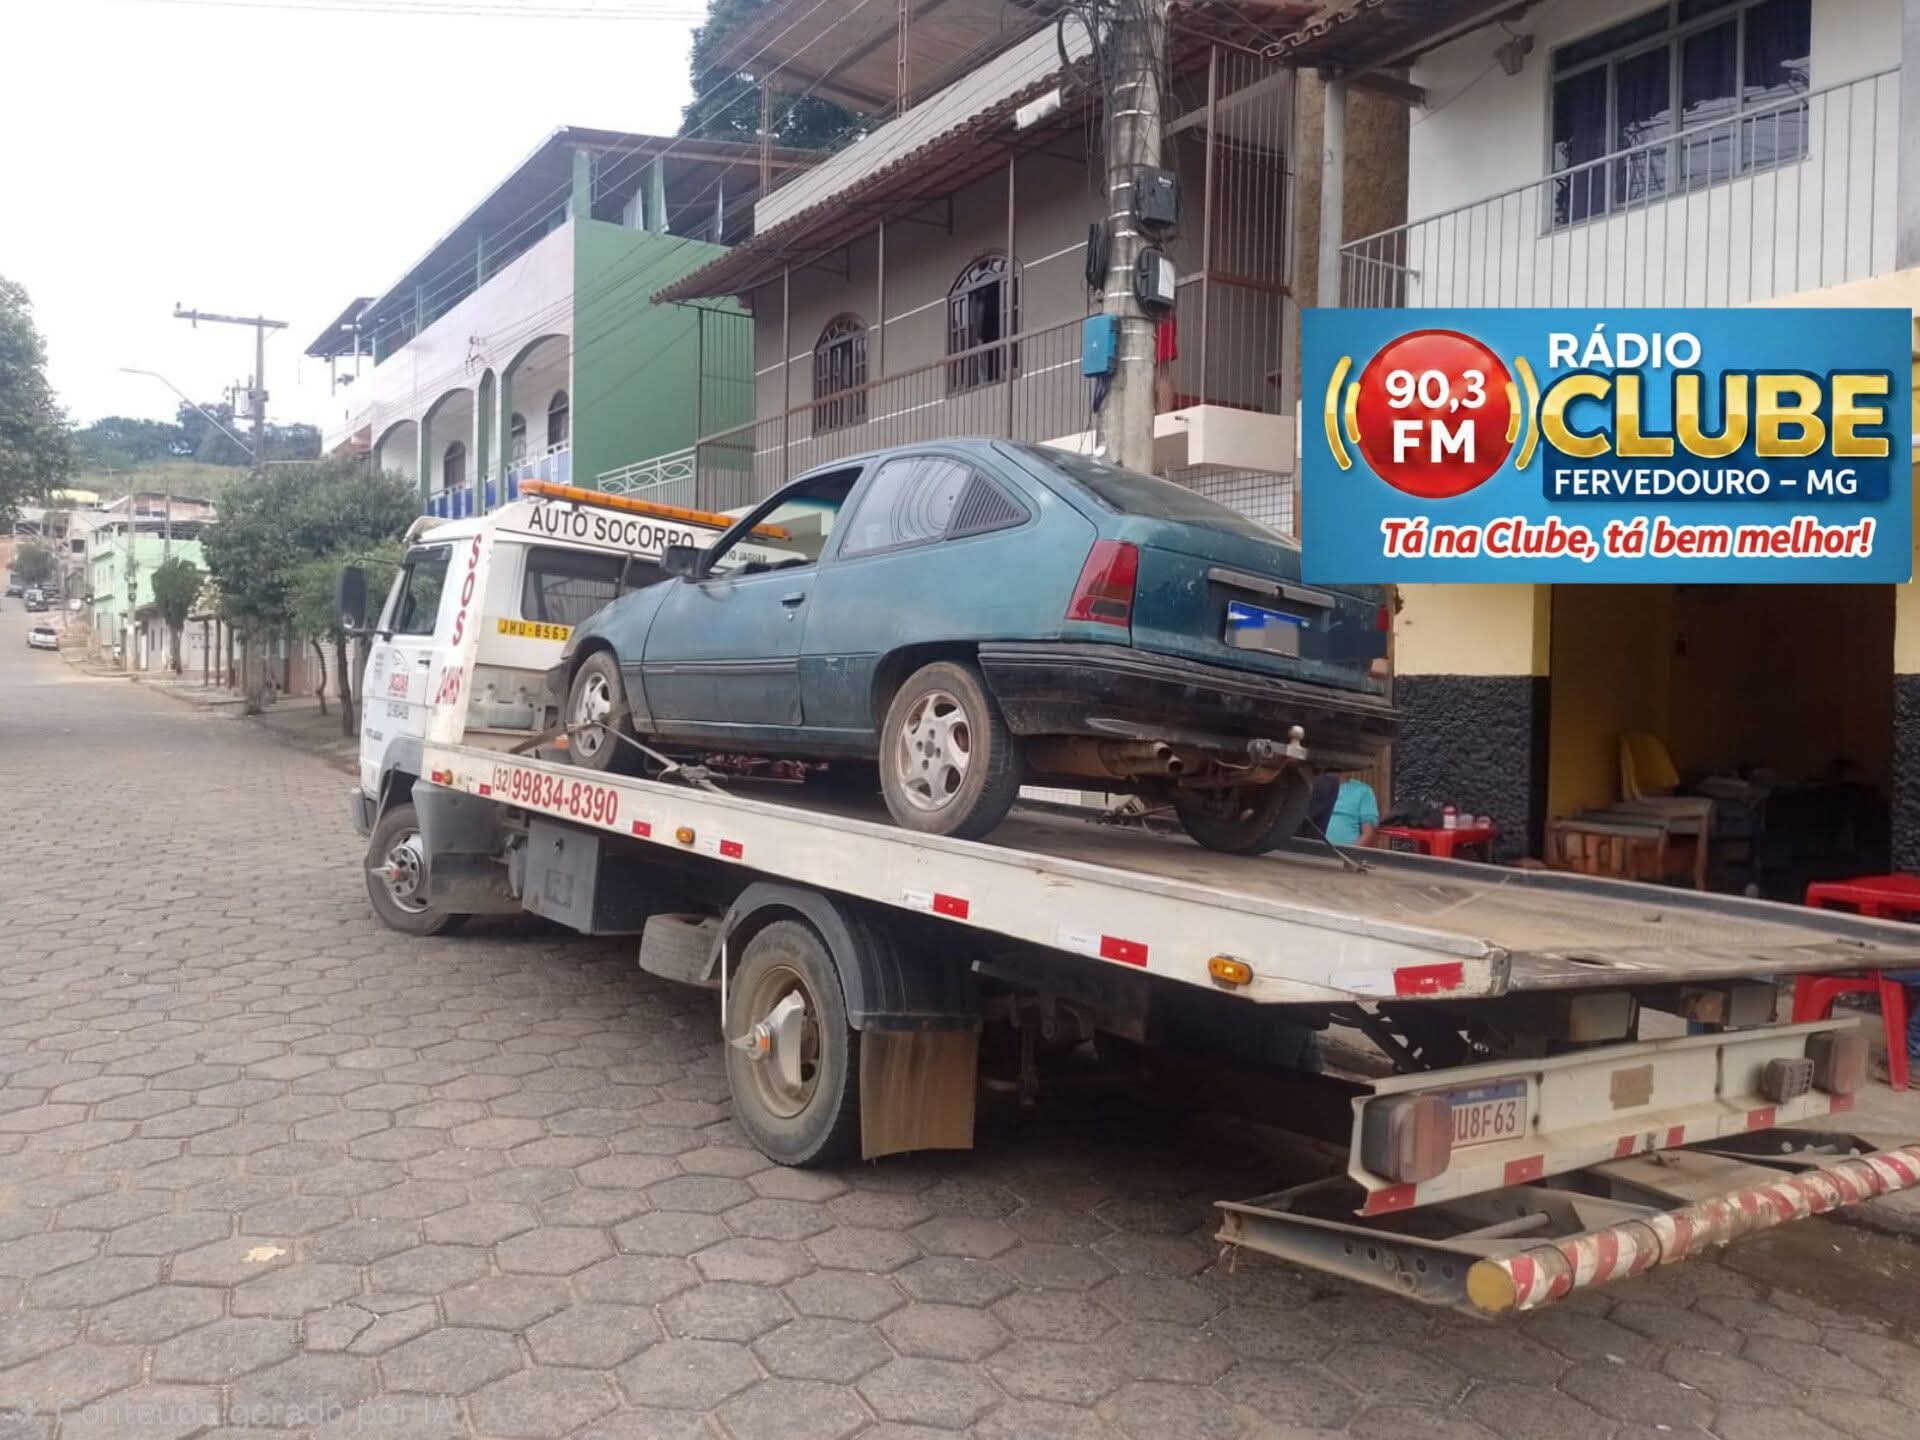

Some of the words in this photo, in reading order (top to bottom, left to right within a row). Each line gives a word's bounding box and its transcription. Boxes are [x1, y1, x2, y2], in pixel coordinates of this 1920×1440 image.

[528, 507, 588, 537] AUTO
[594, 516, 695, 548] SOCORRO
[511, 769, 619, 826] 99834-8390
